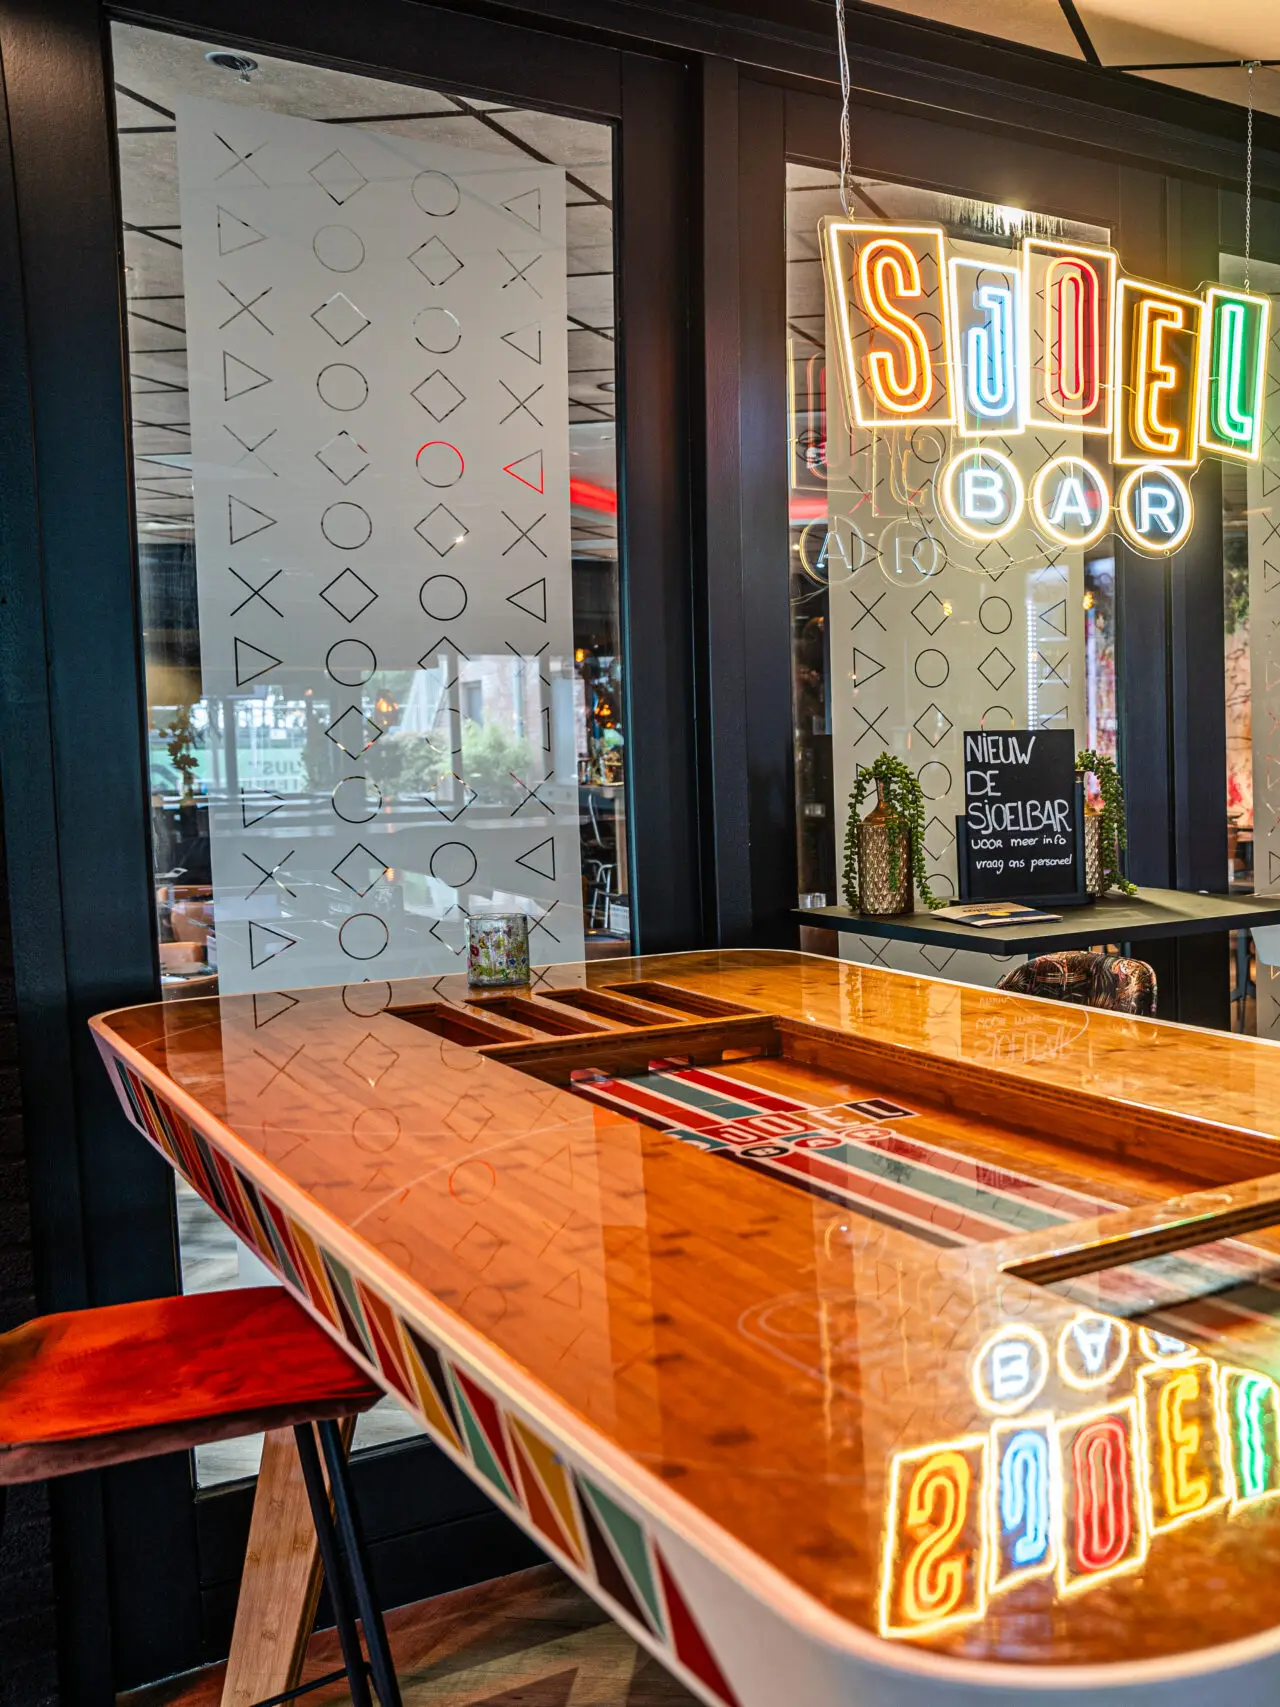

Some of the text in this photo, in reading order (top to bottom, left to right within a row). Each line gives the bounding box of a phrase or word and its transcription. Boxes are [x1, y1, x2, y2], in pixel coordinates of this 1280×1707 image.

[857, 236, 1256, 455] SJOEL
[960, 463, 1178, 537] BAR
[966, 769, 1002, 797] DE
[1010, 837, 1039, 847] meer
[1043, 834, 1067, 846] info
[975, 853, 1073, 875] vraag ons personeel
